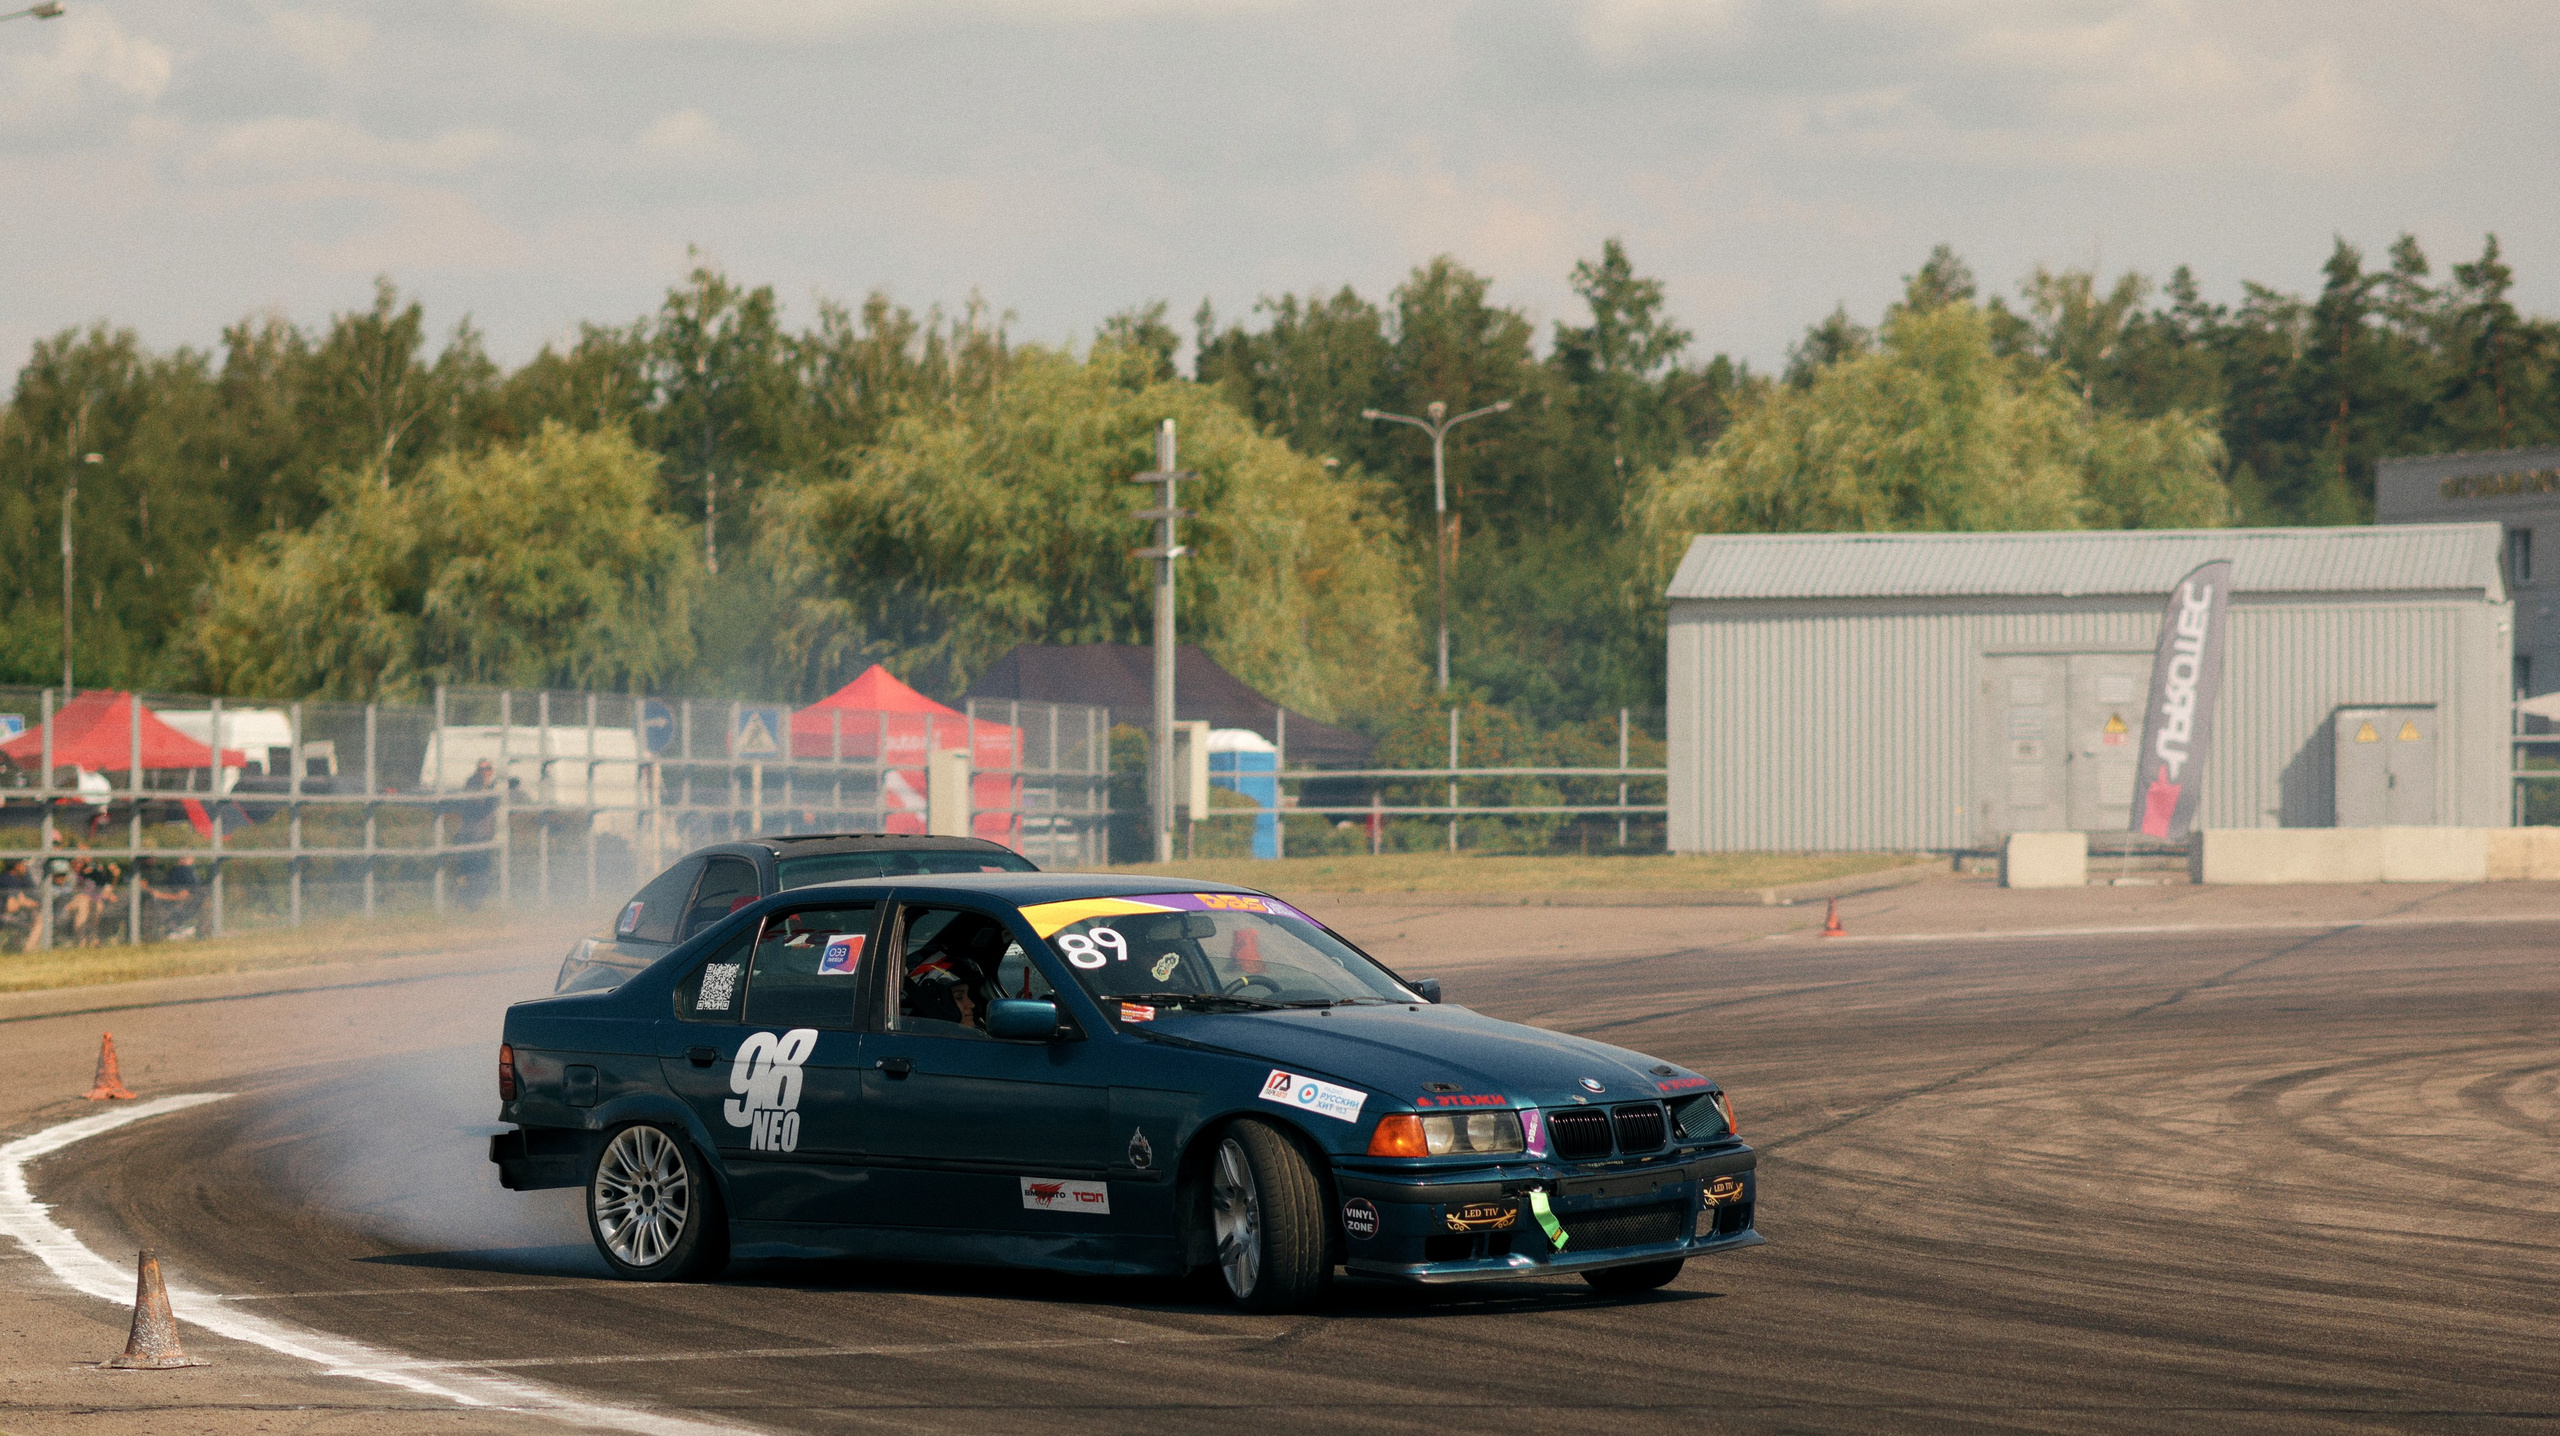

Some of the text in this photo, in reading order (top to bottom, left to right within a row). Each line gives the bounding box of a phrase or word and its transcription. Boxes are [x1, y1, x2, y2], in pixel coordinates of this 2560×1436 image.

[829, 947, 847, 957] ОЭЗ
[1058, 927, 1127, 969] 89
[723, 1028, 818, 1128] 98
[1316, 1100, 1334, 1111] ХИТ
[1320, 1092, 1360, 1108] РУССКИЙ
[750, 1109, 800, 1152] NEO
[1714, 1183, 1725, 1193] LED
[1345, 1208, 1375, 1221] VINYL
[1464, 1207, 1499, 1218] LED TIV
[1347, 1220, 1373, 1233] ZONE
